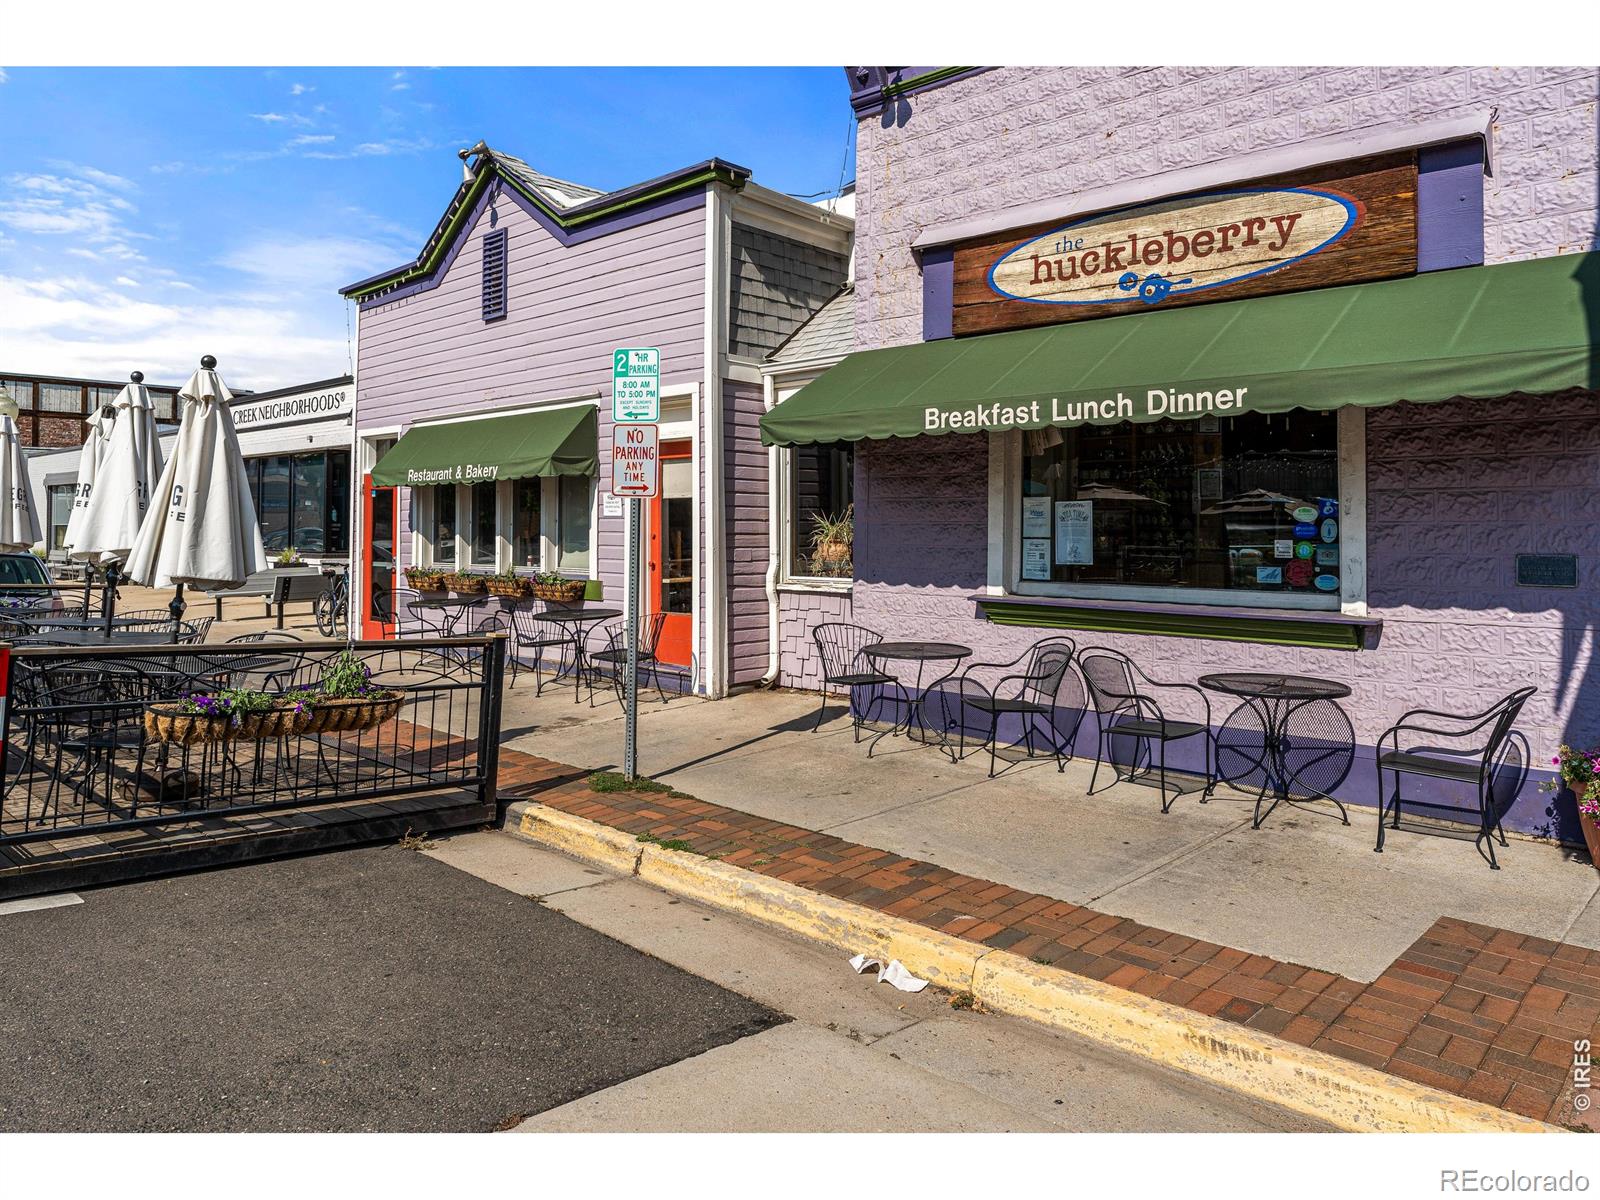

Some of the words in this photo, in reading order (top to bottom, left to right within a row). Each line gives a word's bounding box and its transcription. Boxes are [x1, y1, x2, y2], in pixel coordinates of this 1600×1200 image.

[1028, 211, 1302, 287] huckleberry
[1055, 234, 1083, 254] the
[616, 353, 627, 372] 2
[637, 353, 649, 362] HR
[628, 364, 657, 374] PARKING
[640, 380, 650, 388] AM
[617, 390, 627, 398] TO
[628, 390, 644, 398] 5:00
[646, 390, 656, 398] PM
[924, 400, 1040, 430] Breakfast
[1052, 392, 1133, 422] Lunch
[1147, 387, 1248, 415] Dinner
[233, 407, 258, 425] CREEK
[626, 430, 644, 444] NO
[615, 446, 655, 460] PARKING
[407, 467, 453, 482] Restaurant
[455, 465, 462, 479] &
[465, 463, 499, 479] Bakery
[625, 461, 644, 471] ANY
[623, 472, 645, 482] TIME
